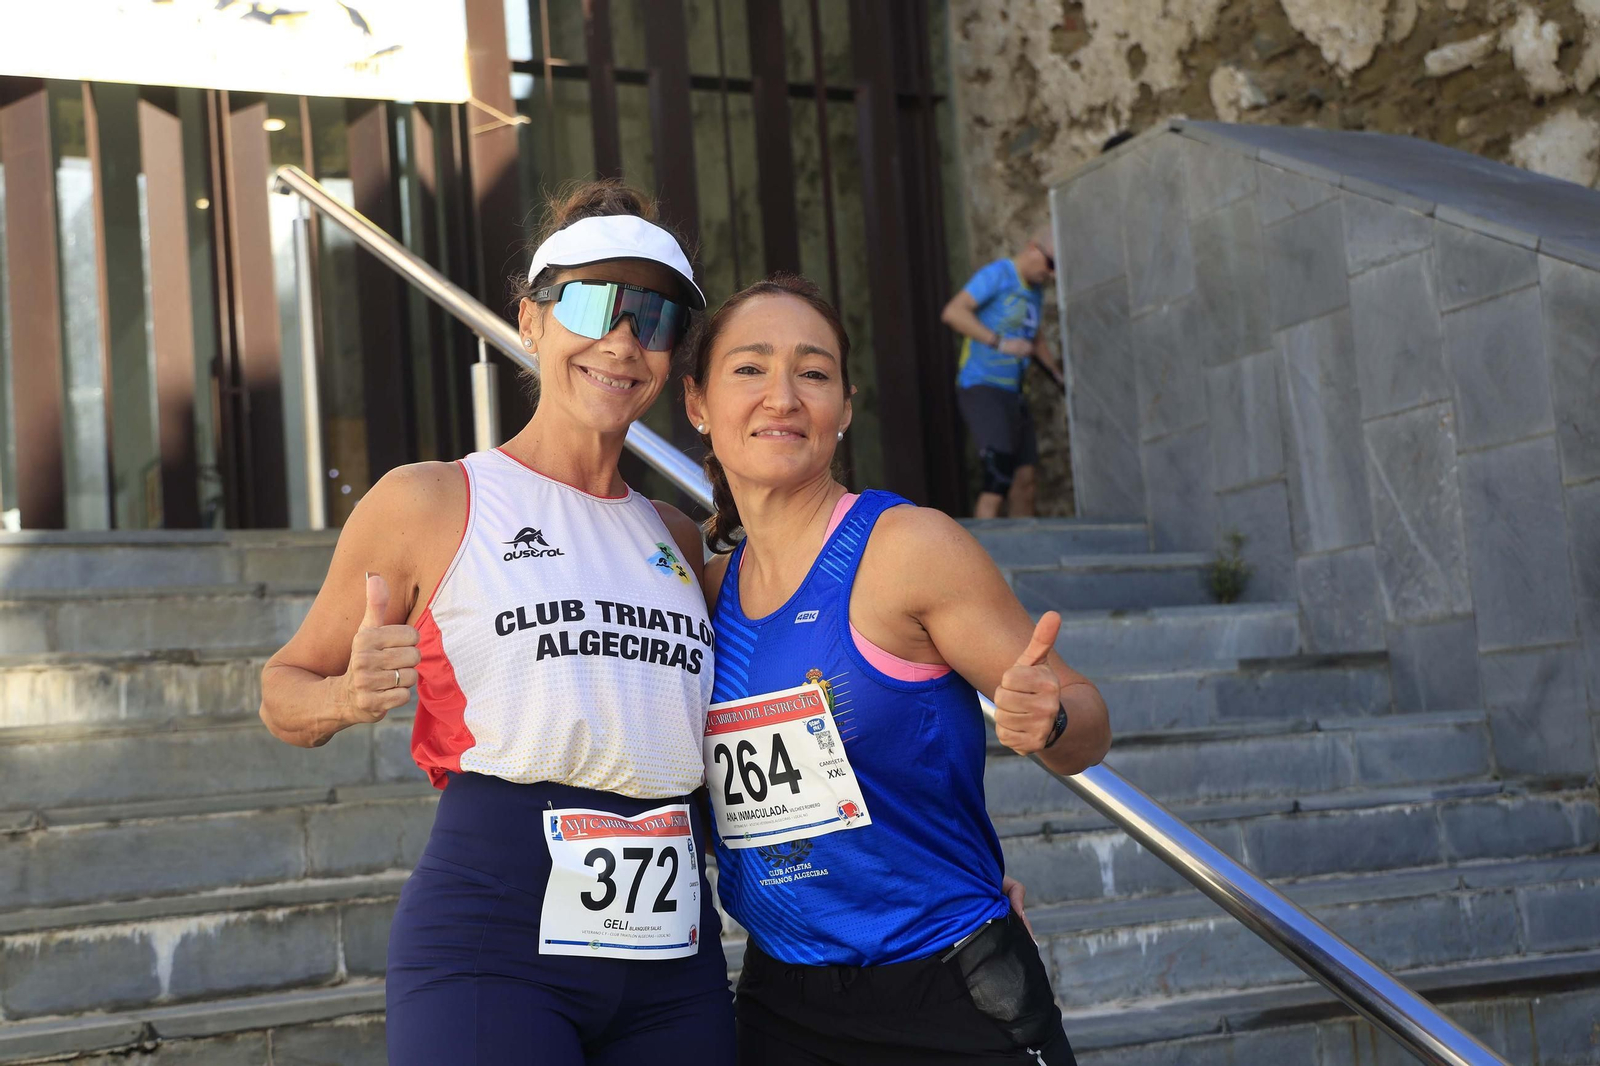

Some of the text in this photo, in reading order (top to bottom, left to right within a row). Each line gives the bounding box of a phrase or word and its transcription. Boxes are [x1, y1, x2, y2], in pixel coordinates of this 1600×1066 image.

[503, 548, 565, 561] austral
[494, 599, 586, 637] CLUB
[536, 629, 704, 675] ALGECIRAS
[710, 710, 745, 726] CARRERA
[744, 707, 764, 720] DEL
[713, 732, 803, 806] 264
[819, 757, 845, 768] CAMISETA
[827, 767, 847, 779] XXL
[726, 811, 739, 822] ANA
[738, 804, 789, 821] INMACULADA
[645, 816, 671, 831] DEL
[768, 862, 812, 877] CLUB ATLETAS
[793, 868, 829, 881] ALGECIRAS
[580, 845, 679, 914] 372
[603, 918, 629, 930] GELI
